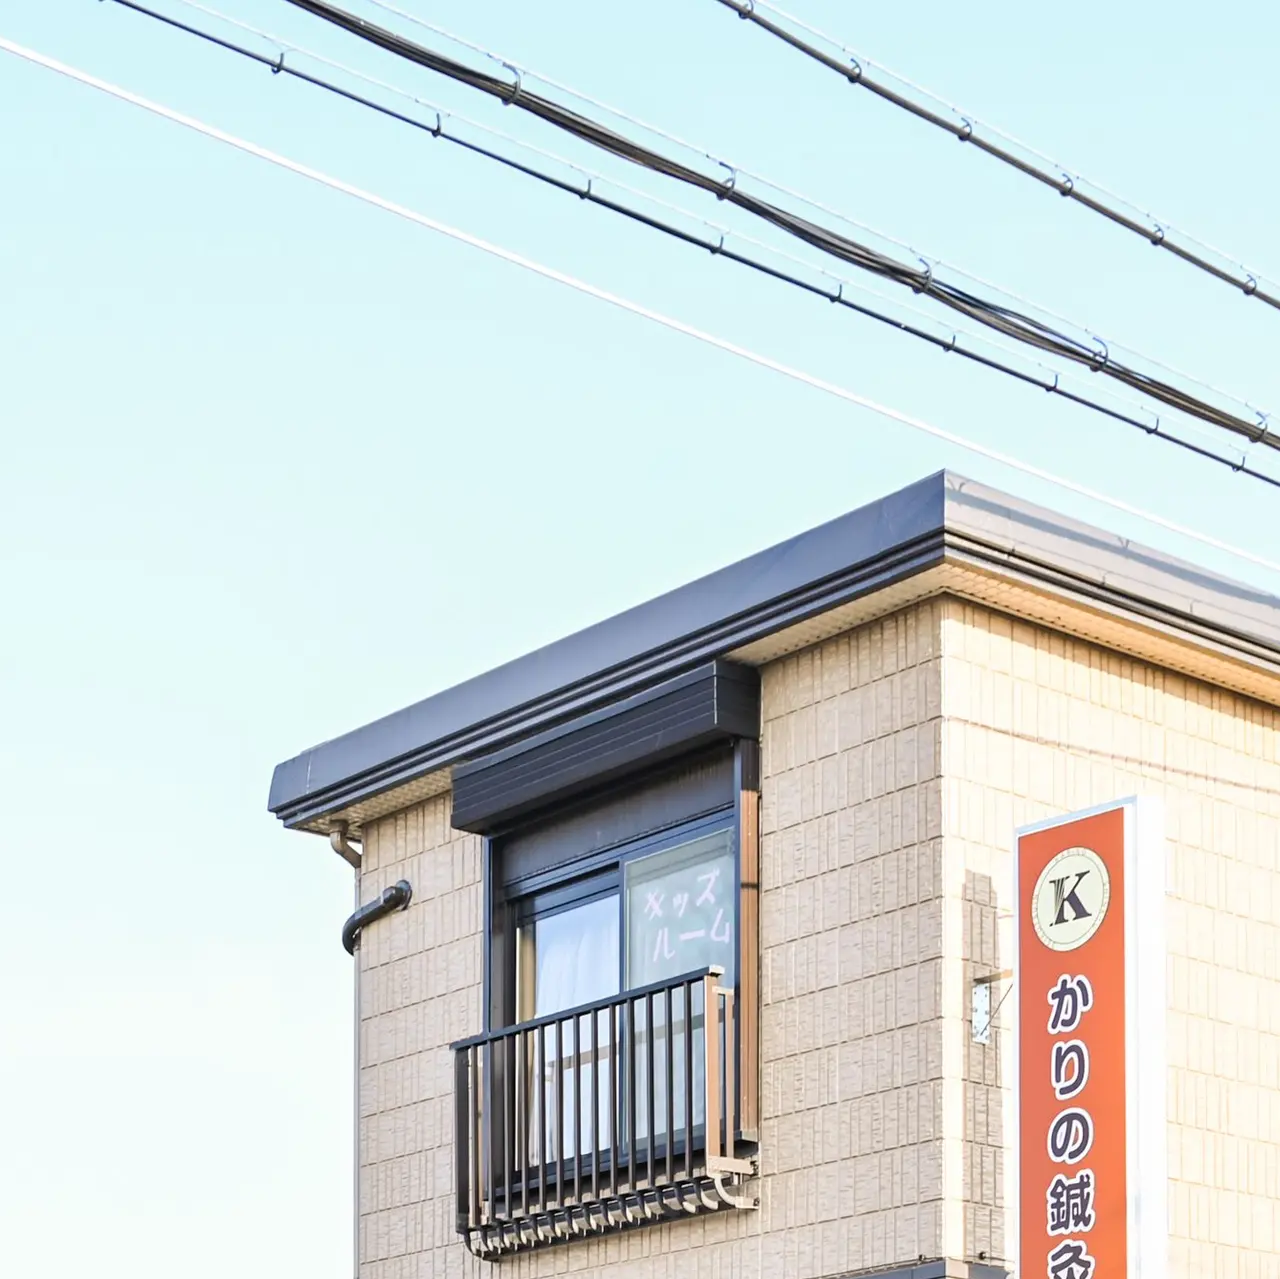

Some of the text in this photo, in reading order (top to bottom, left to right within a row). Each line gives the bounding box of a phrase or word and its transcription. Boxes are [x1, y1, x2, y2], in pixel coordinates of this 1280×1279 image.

[644, 867, 720, 921] キッズ
[1049, 870, 1092, 927] K
[653, 908, 730, 962] ルーム
